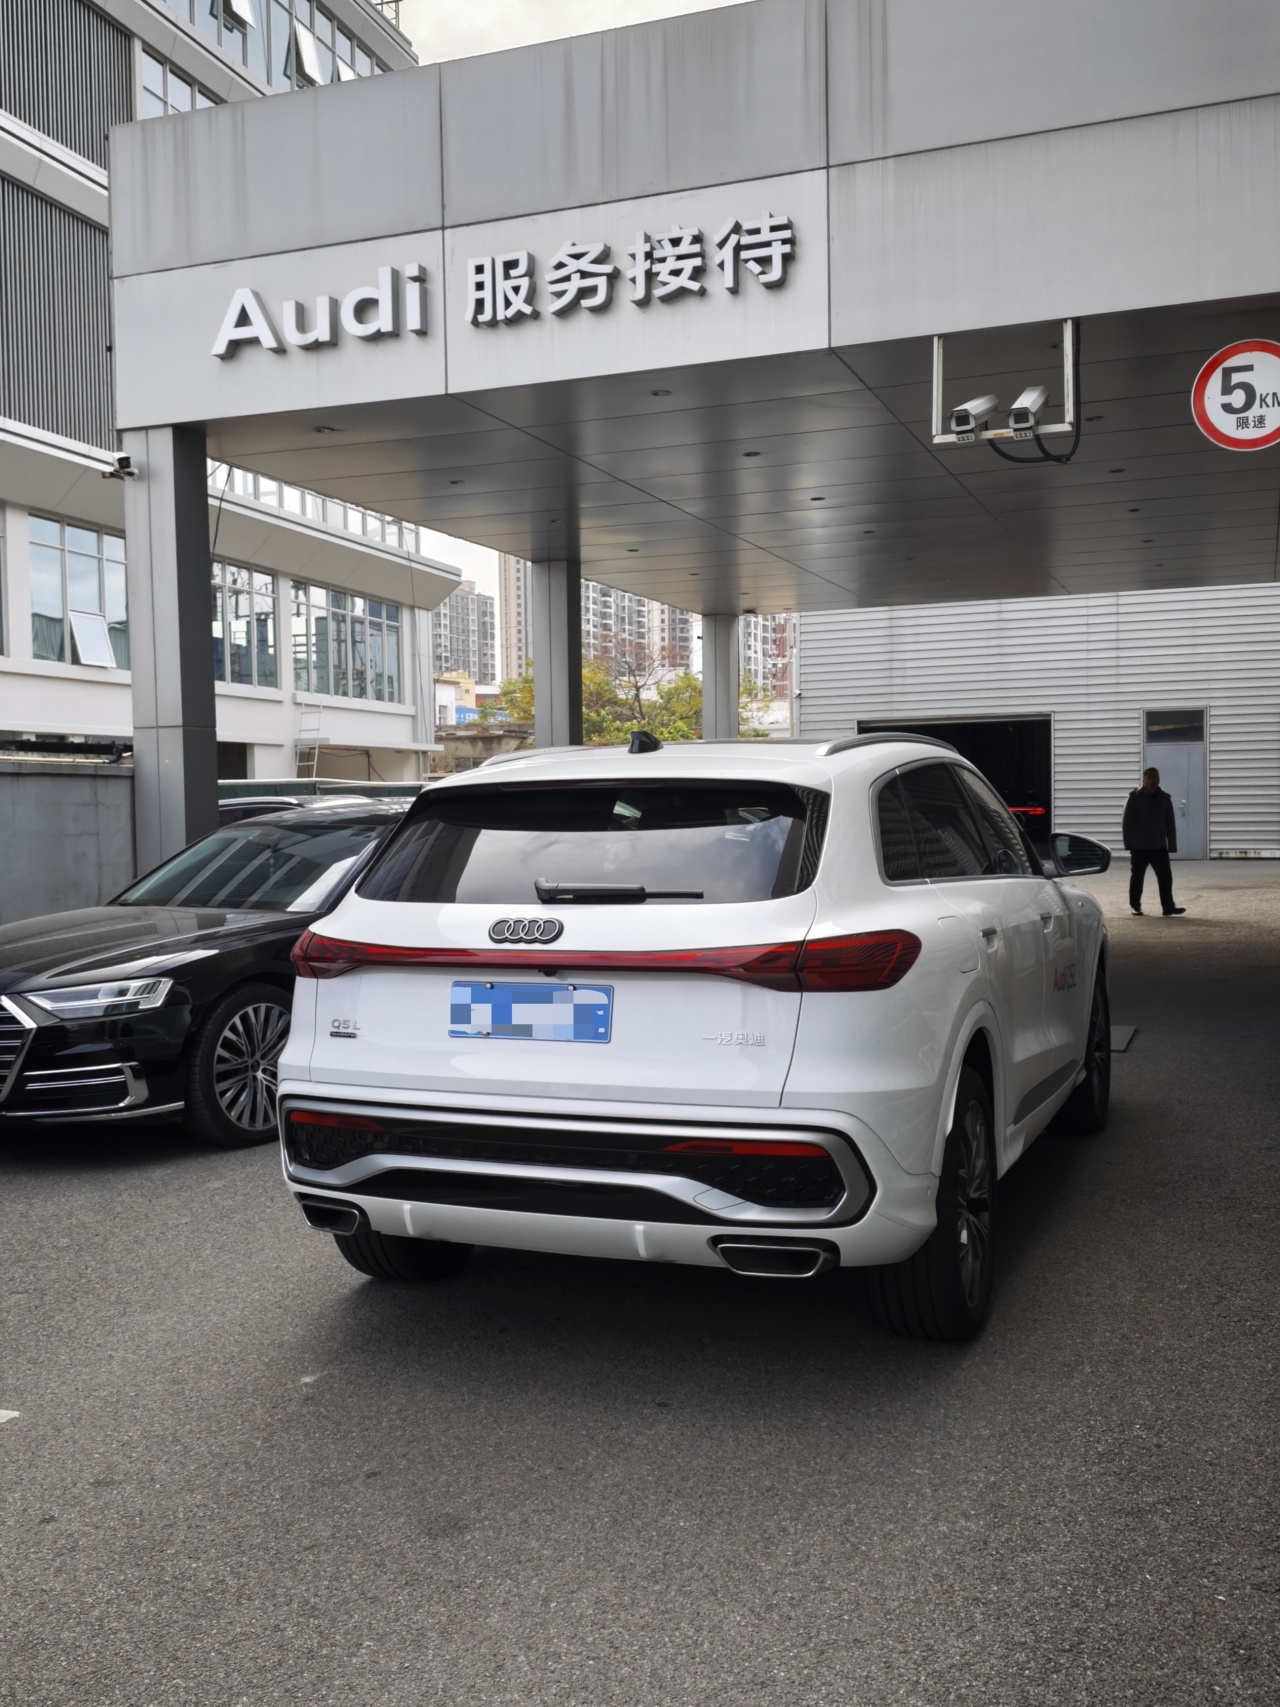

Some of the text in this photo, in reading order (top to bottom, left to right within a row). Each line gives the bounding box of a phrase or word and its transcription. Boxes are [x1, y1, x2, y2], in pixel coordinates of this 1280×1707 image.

[210, 211, 796, 361] Audi 服务接待
[1236, 414, 1267, 431] 限速
[701, 1031, 766, 1046] 一汽奥迪
